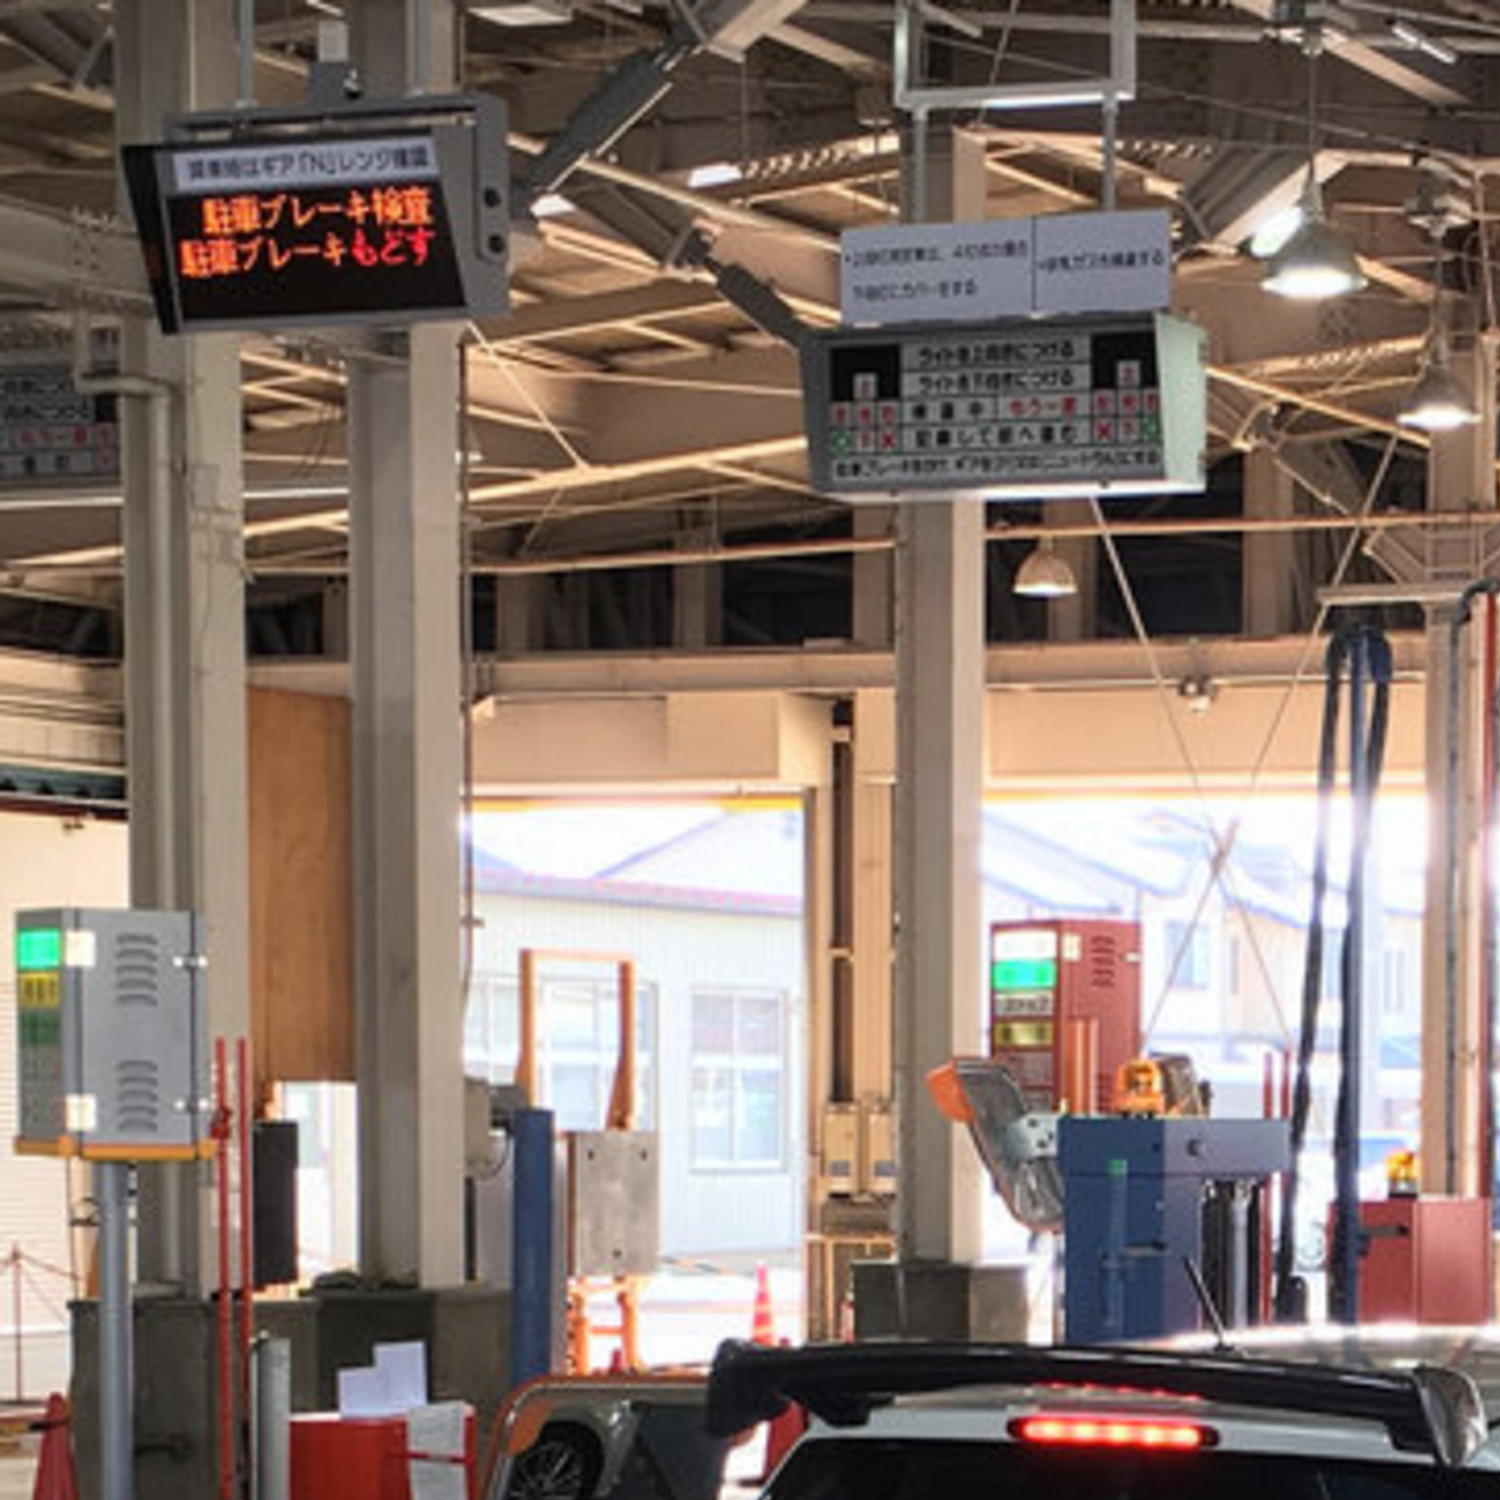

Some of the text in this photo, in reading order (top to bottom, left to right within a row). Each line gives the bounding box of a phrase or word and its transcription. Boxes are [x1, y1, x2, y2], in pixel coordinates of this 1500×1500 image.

[202, 186, 433, 234] 駐車ブレーキ検査
[180, 230, 434, 278] 駐車ブレーキもどす
